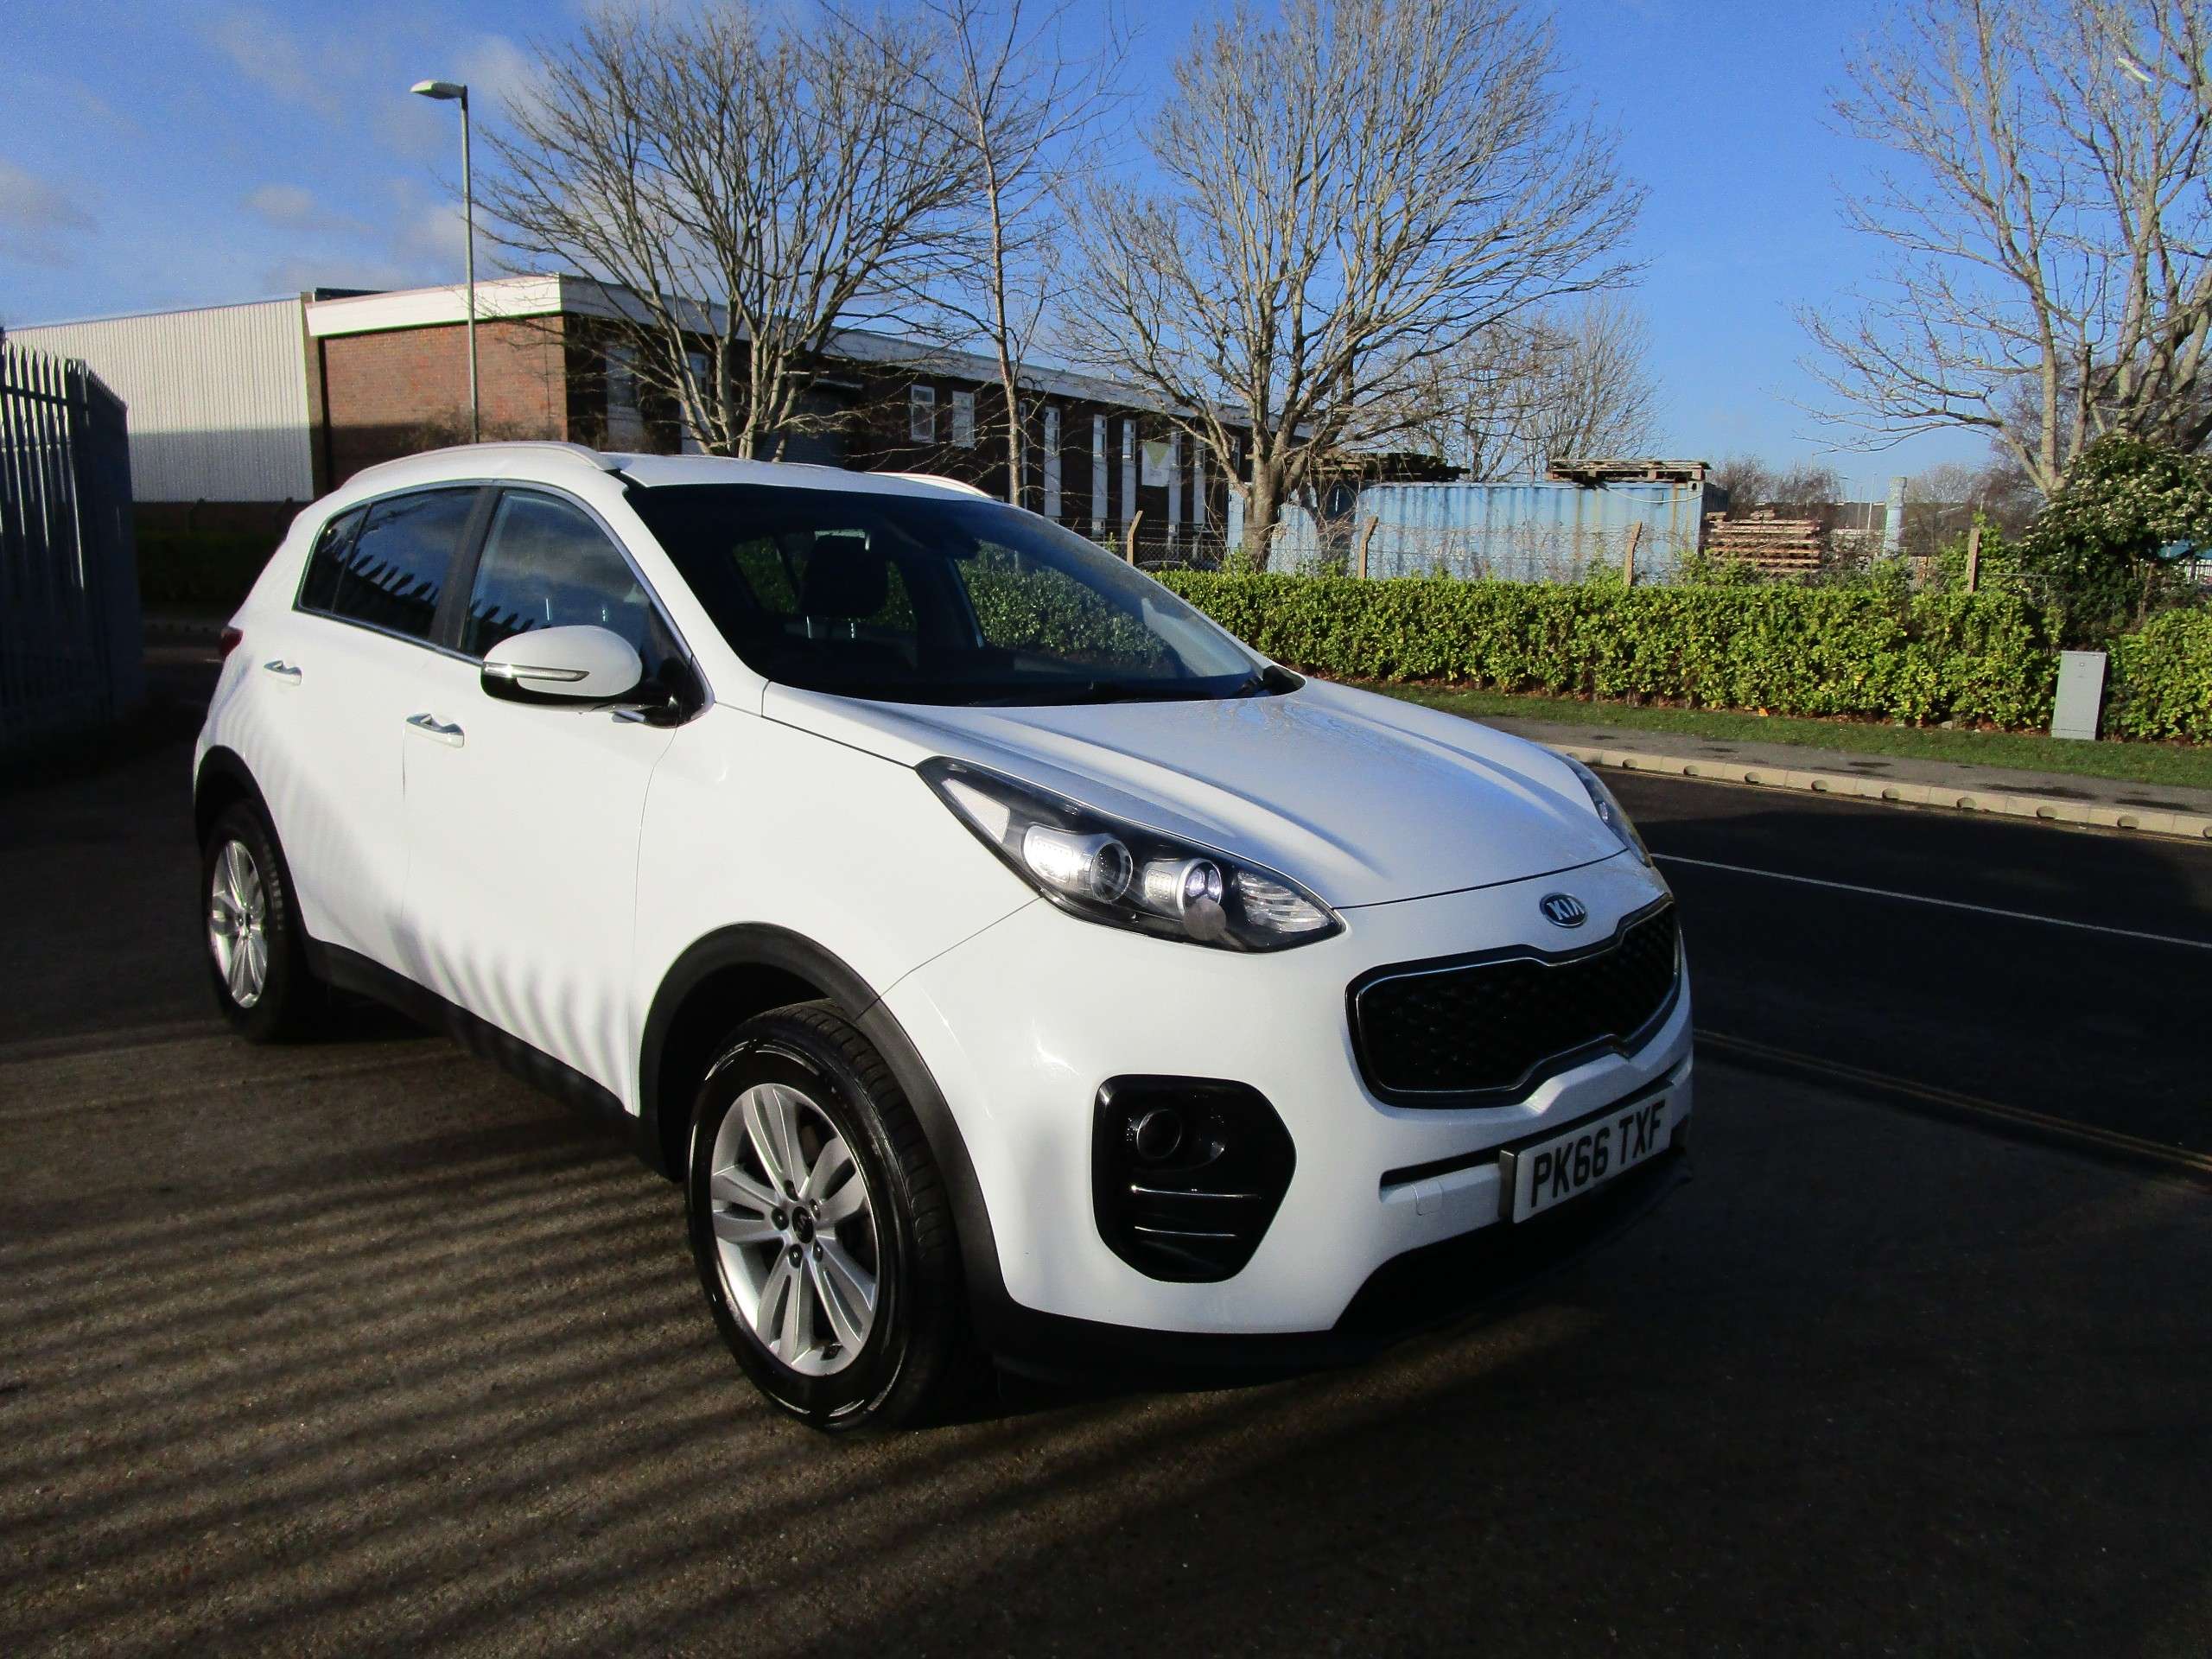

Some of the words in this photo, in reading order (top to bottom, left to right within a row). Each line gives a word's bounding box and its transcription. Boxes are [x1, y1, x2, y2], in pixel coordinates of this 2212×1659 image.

[1546, 898, 1585, 920] KIA
[1531, 1127, 1611, 1208] PK66
[1618, 1098, 1666, 1165] TXF
